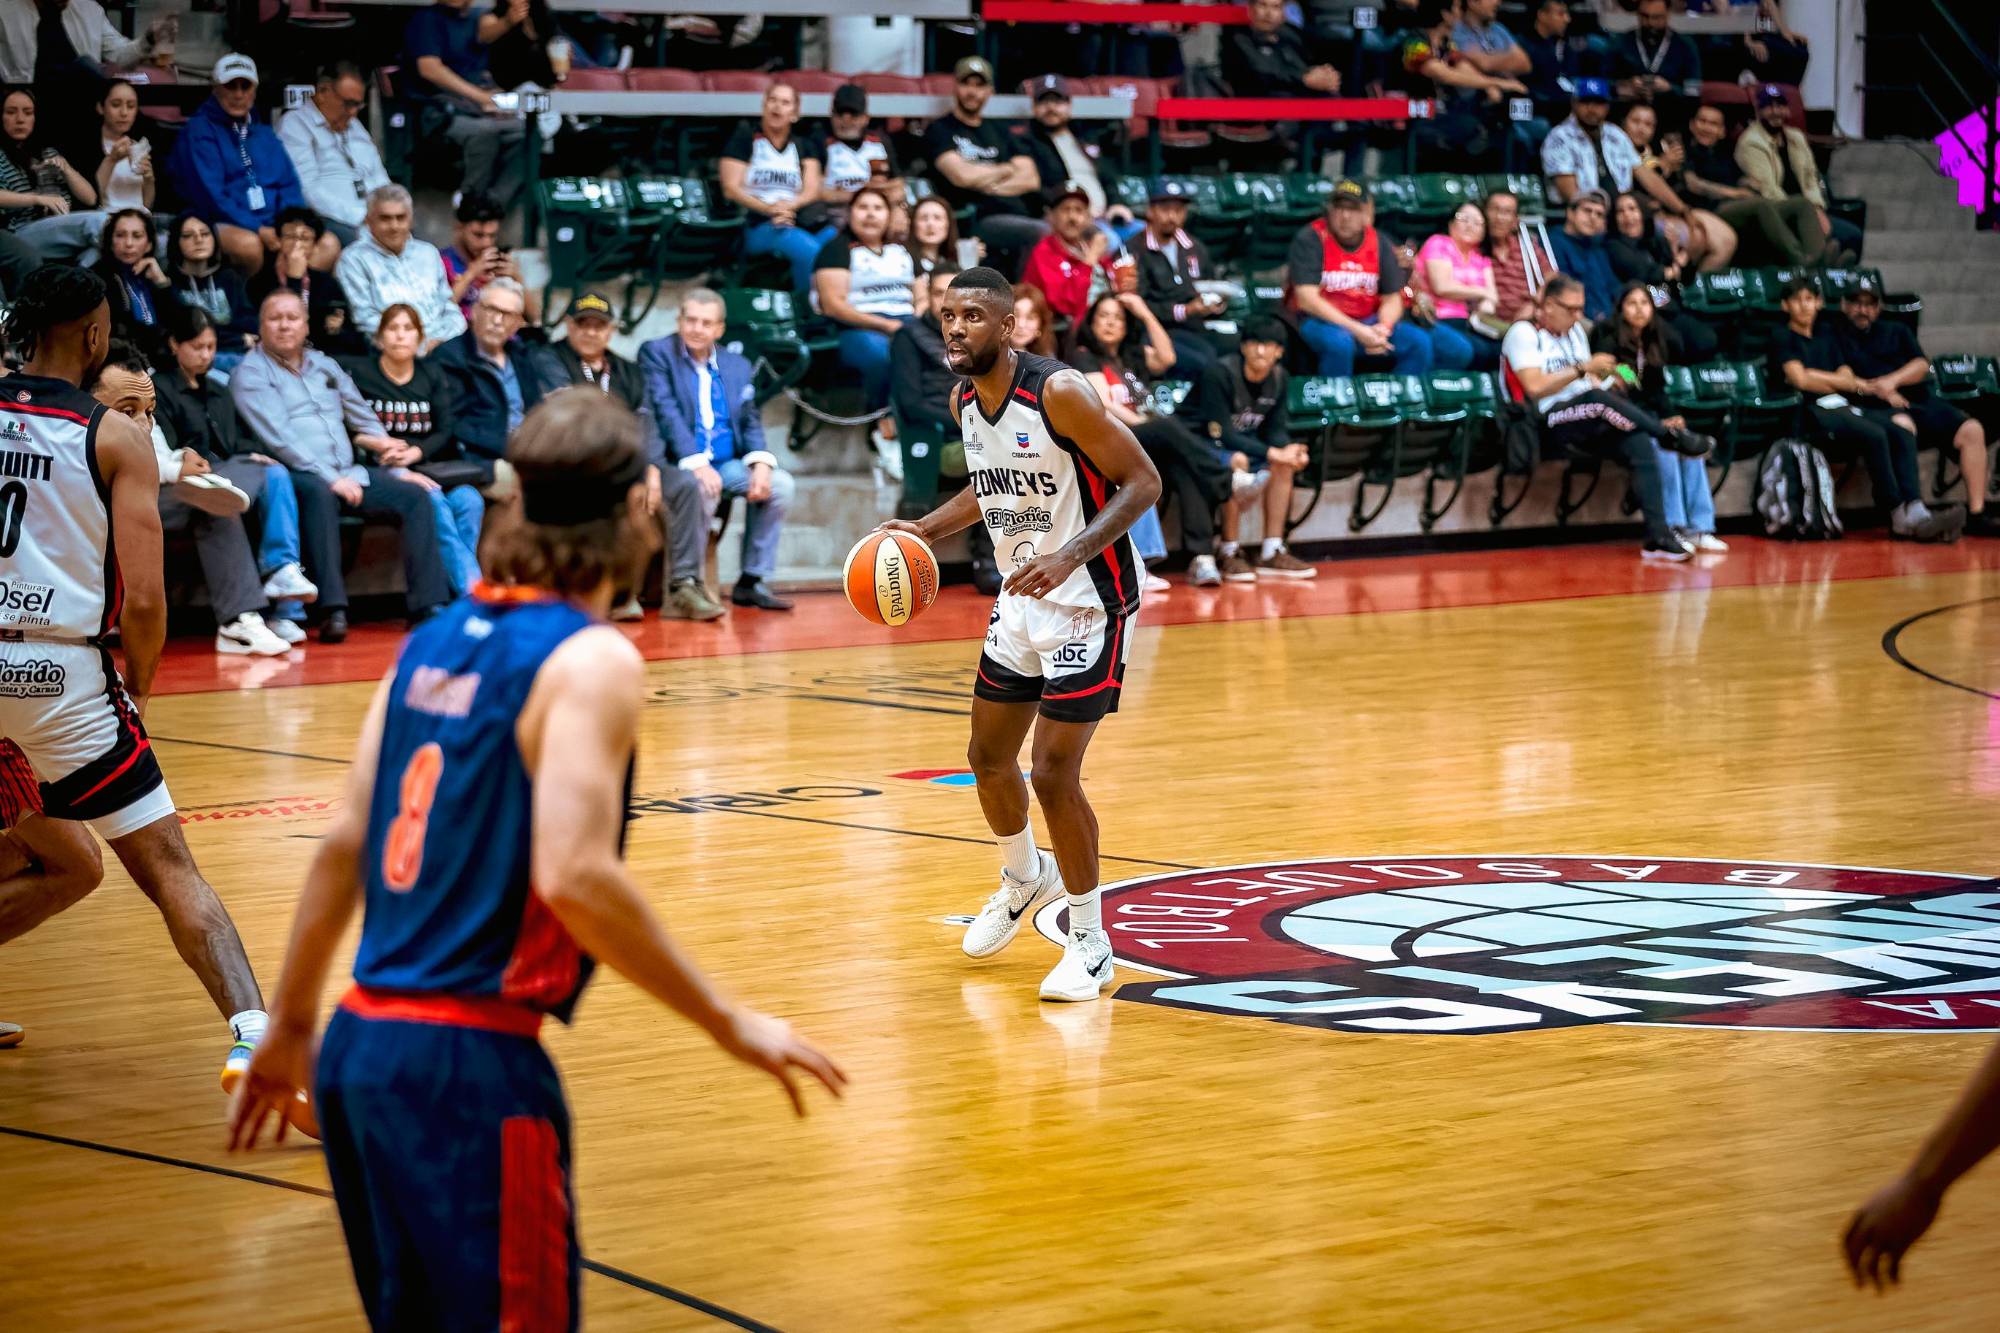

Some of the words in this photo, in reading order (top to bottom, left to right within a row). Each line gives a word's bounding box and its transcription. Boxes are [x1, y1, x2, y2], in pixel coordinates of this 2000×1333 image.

[969, 468, 1058, 498] ZONKEYS
[987, 511, 1002, 526] El
[11, 580, 47, 593] Pinturas
[884, 557, 906, 618] SPALDING
[2, 612, 16, 621] se
[18, 614, 51, 626] pinta
[1052, 643, 1088, 662] abc
[381, 741, 445, 893] 8
